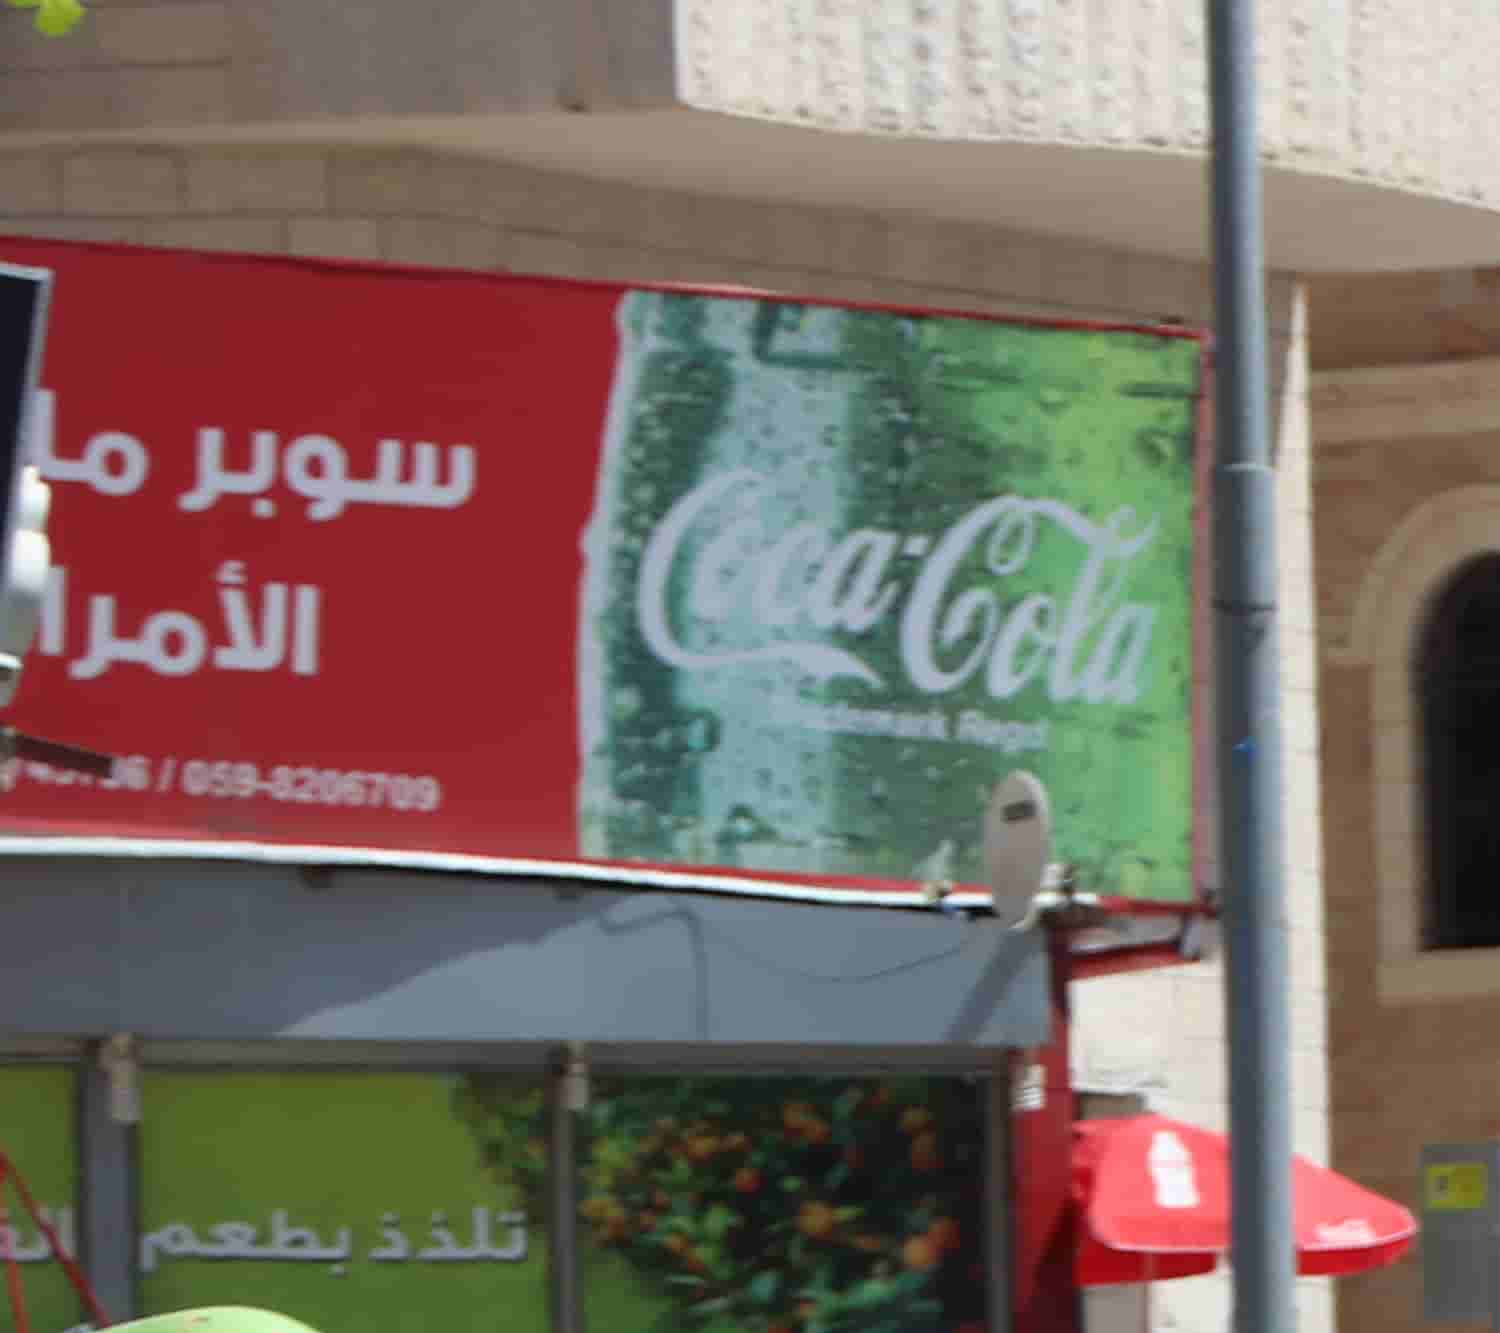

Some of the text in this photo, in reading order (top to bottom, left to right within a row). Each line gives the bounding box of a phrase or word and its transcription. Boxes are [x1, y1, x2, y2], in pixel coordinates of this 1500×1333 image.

[36, 388, 478, 522] سوبر ما
[38, 559, 322, 680] الأمرا
[637, 468, 1160, 704] Coca-Cola
[140, 1210, 352, 1279] بطعم
[368, 1206, 528, 1264] تلذذ
